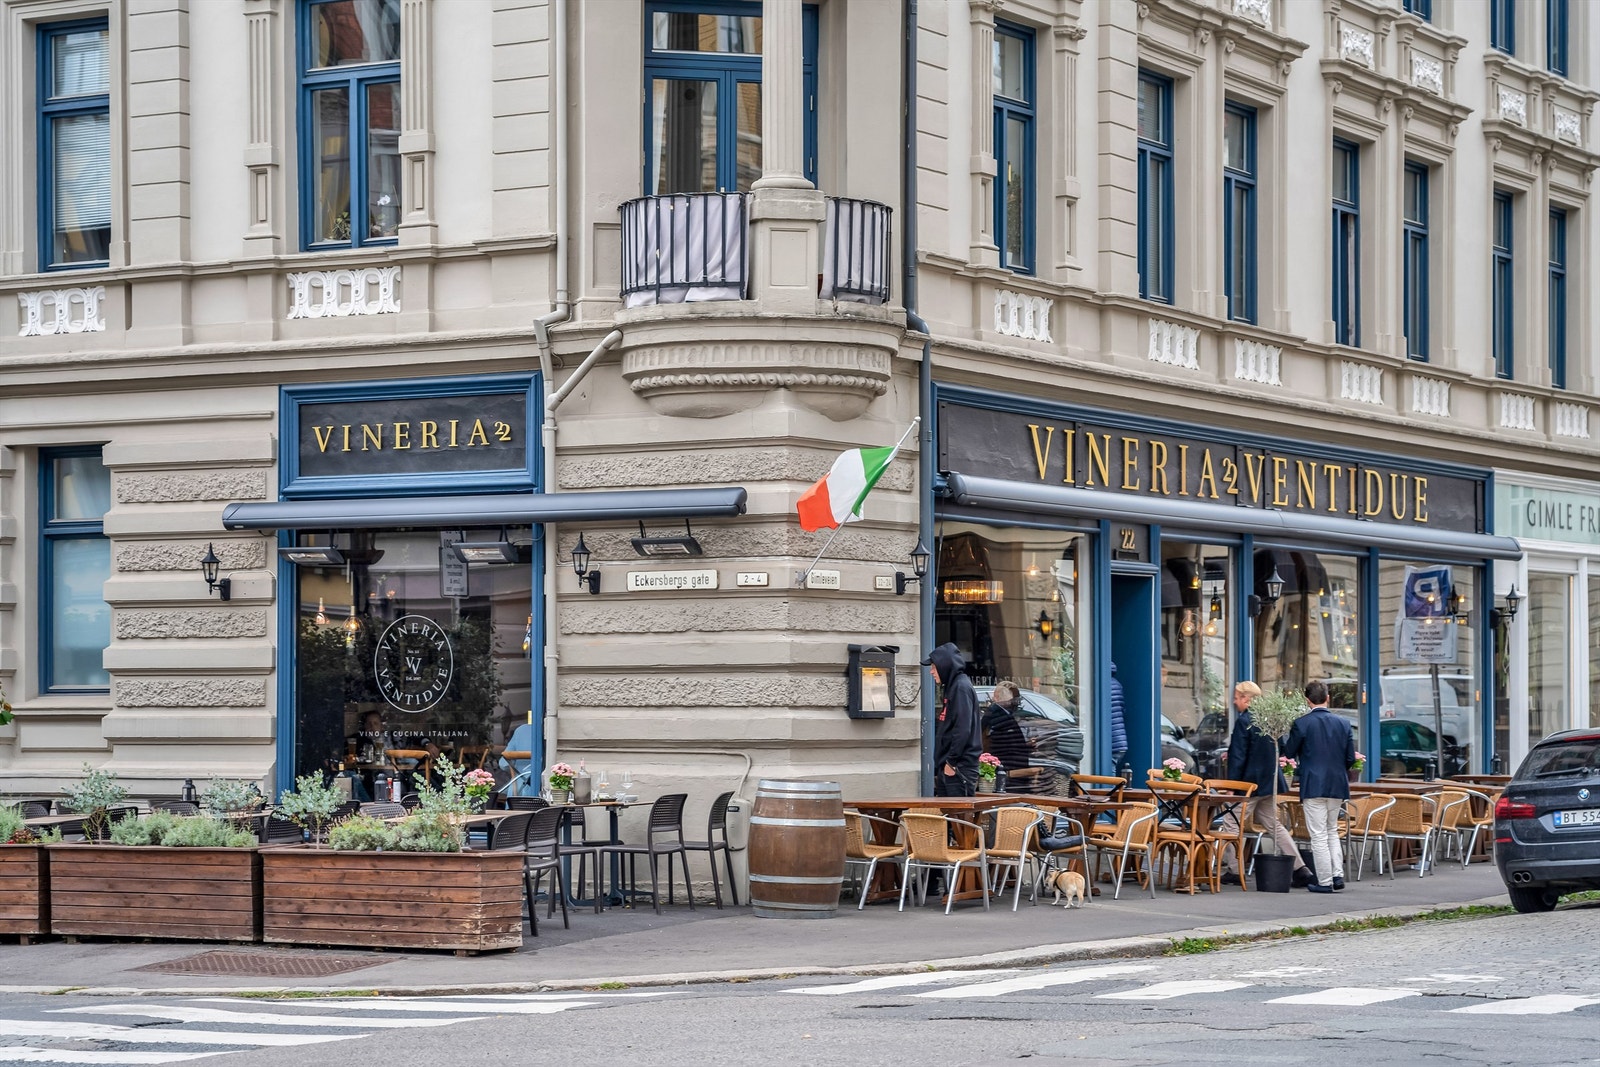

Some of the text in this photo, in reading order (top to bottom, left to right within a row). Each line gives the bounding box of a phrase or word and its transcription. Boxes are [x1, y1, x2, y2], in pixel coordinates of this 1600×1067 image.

[312, 418, 490, 453] VINERIA
[1028, 424, 1220, 499] VINERIA
[1243, 453, 1429, 523] VENTIDUE
[1526, 498, 1573, 531] GIMLE
[1120, 528, 1136, 550] 22
[634, 574, 710, 590] Eckersbergs gate
[381, 622, 445, 651] VINERIA
[379, 667, 448, 705] VENTIDUE
[1563, 812, 1577, 823] BT
